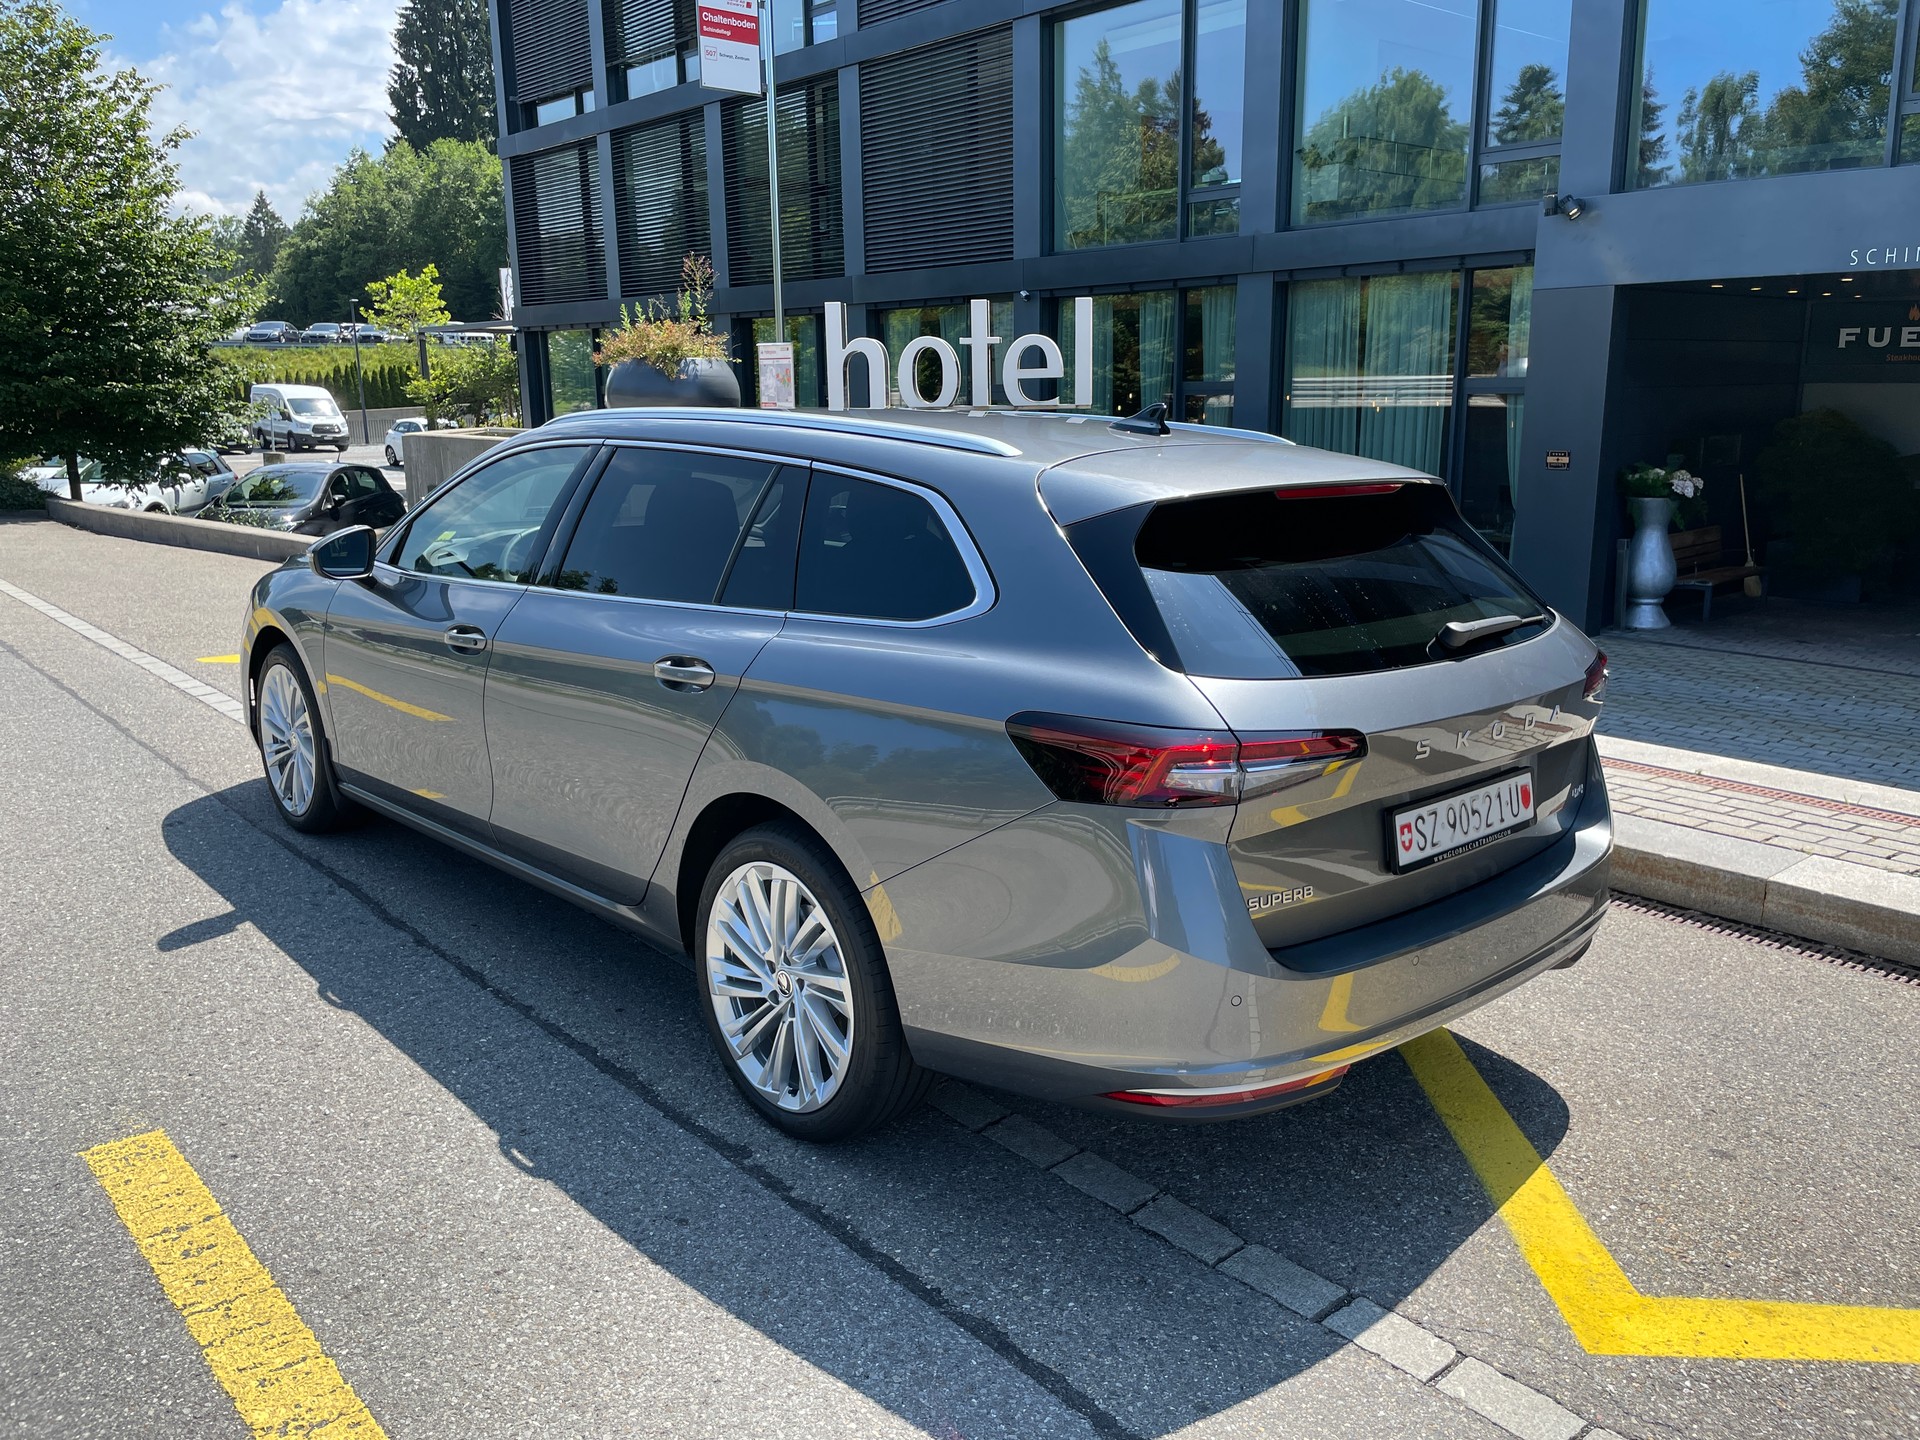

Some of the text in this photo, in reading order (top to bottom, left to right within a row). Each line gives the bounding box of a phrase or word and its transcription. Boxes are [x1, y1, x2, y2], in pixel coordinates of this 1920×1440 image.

[702, 11, 756, 30] Chaltenboden
[705, 49, 717, 57] 507
[824, 297, 1093, 411] hotel
[1247, 884, 1314, 912] SUPERB
